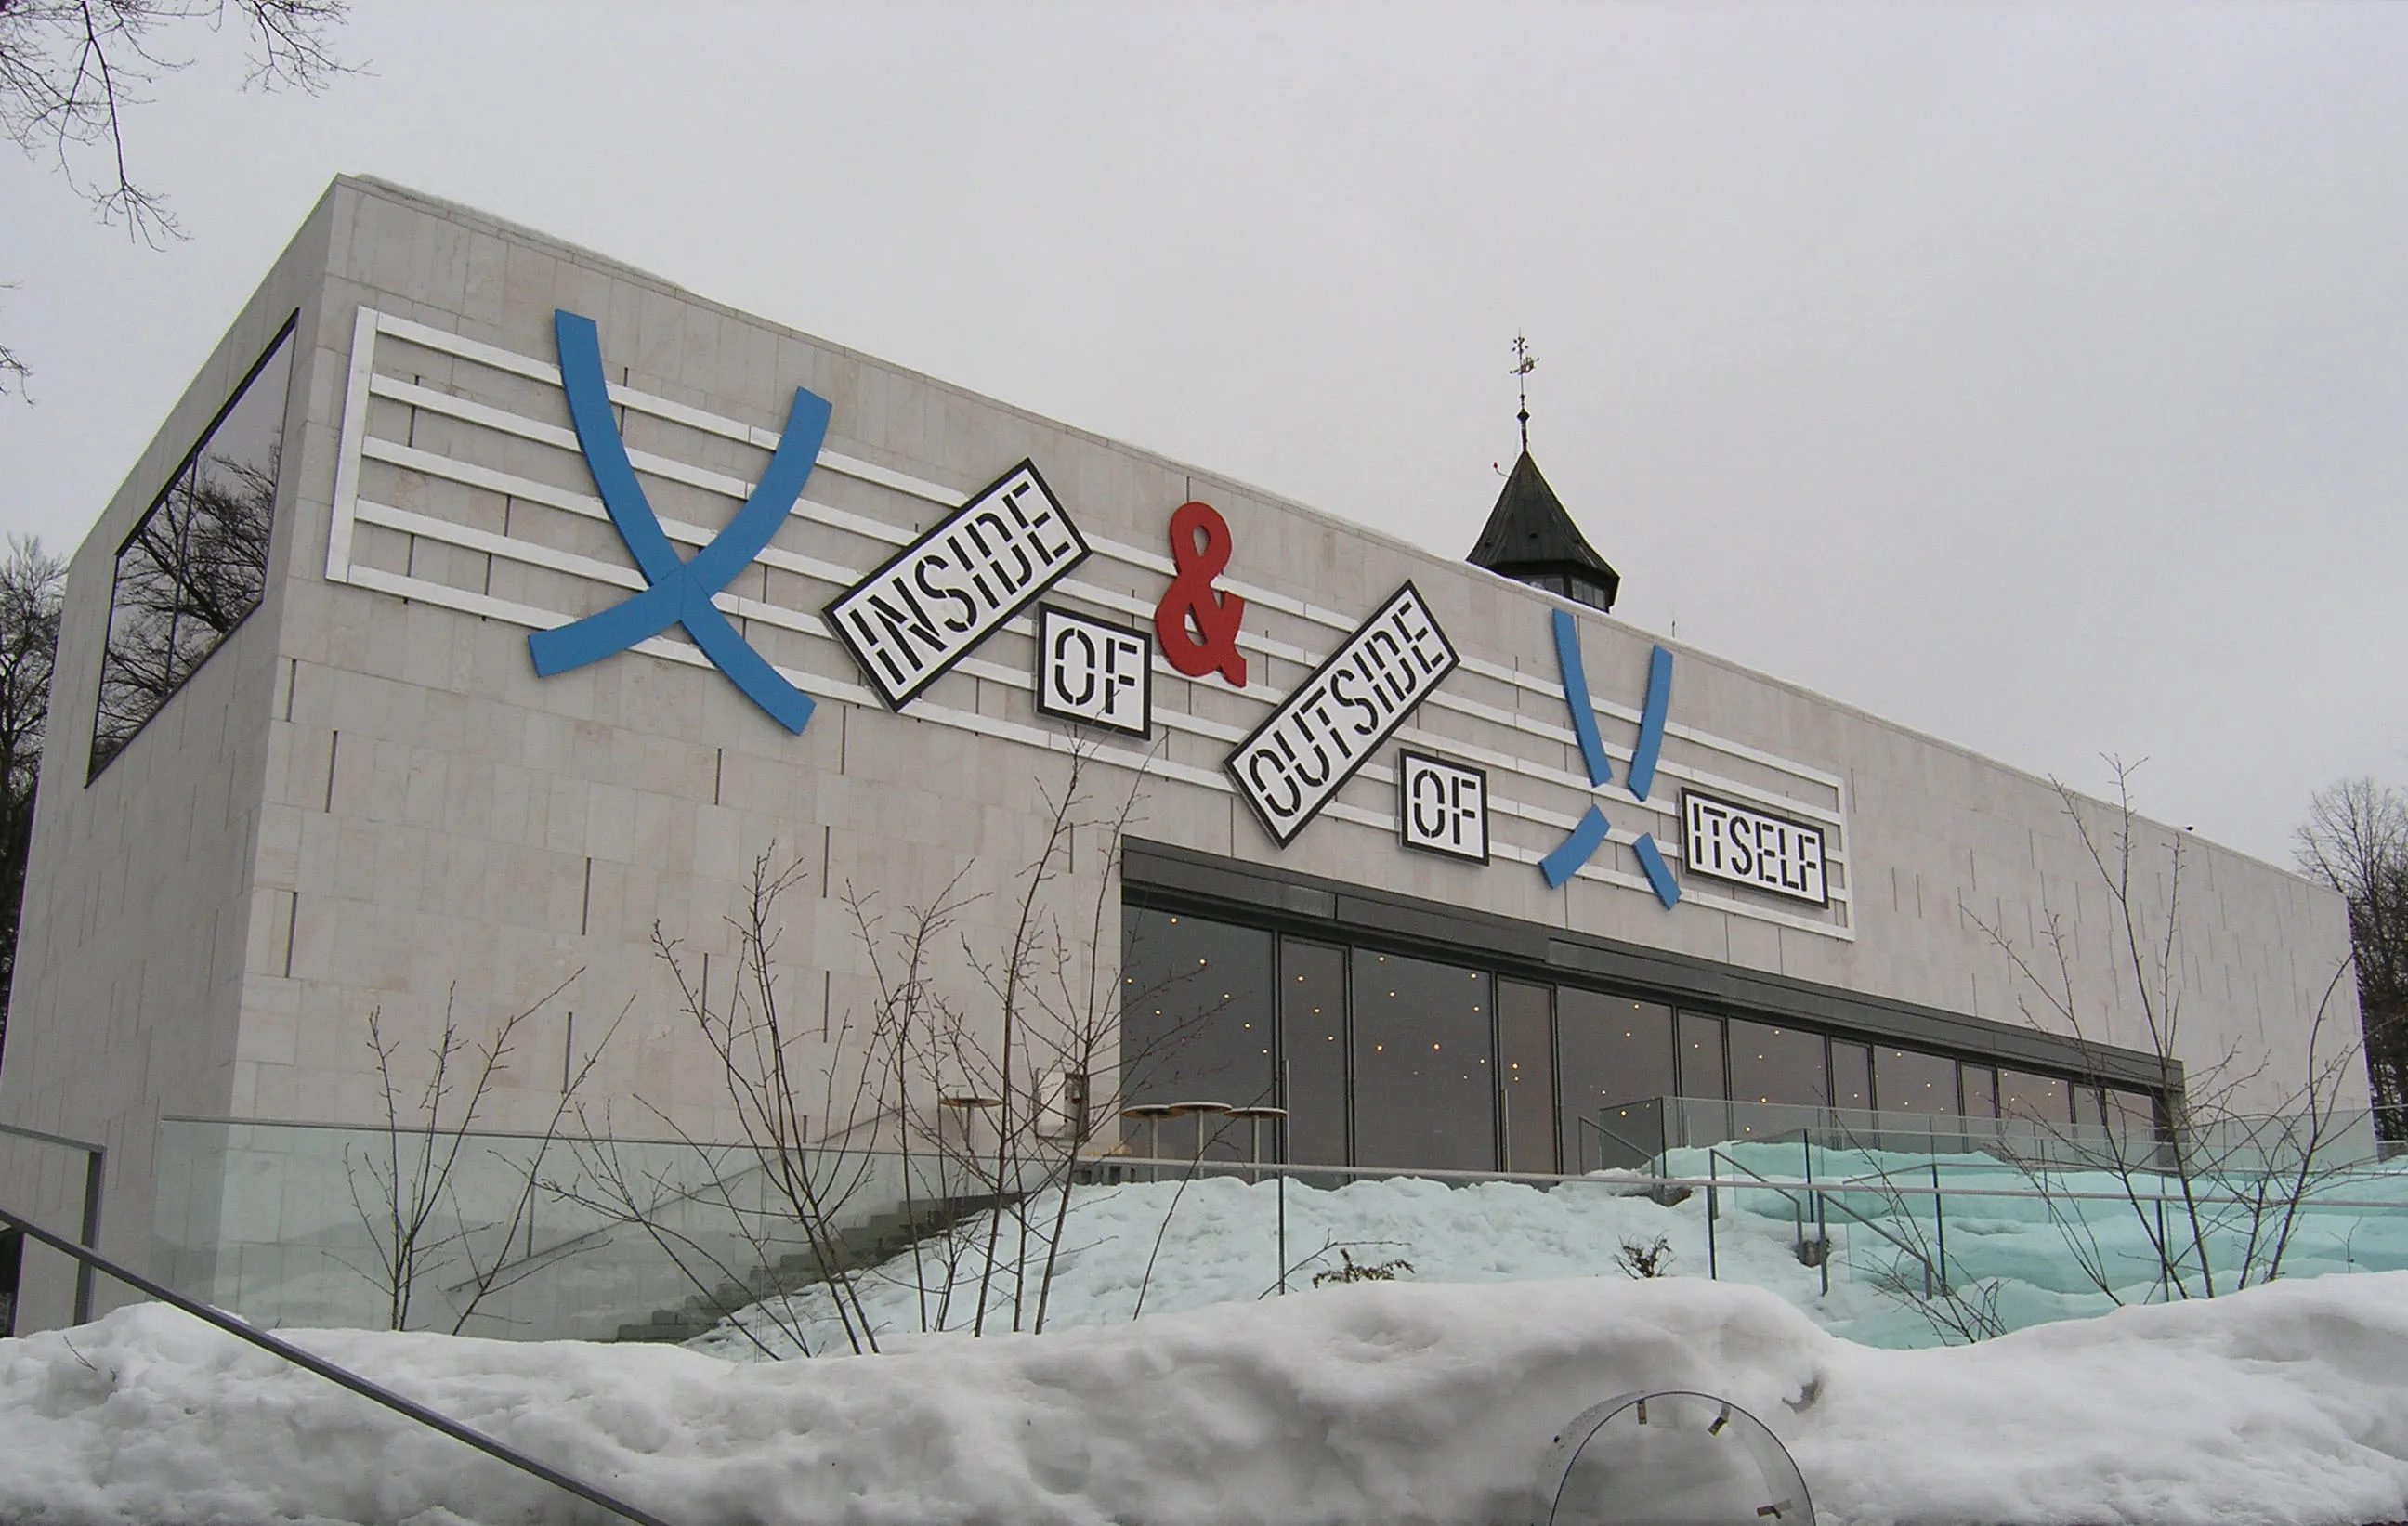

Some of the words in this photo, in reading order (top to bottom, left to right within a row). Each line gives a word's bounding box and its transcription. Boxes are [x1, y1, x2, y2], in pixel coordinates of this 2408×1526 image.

[848, 480, 1072, 686] INSIDE
[1155, 502, 1247, 688] &
[1054, 627, 1138, 715] OF
[1249, 600, 1445, 818] OUTSIDE
[1413, 769, 1476, 845] OF
[1693, 802, 1817, 892] ITSELF
